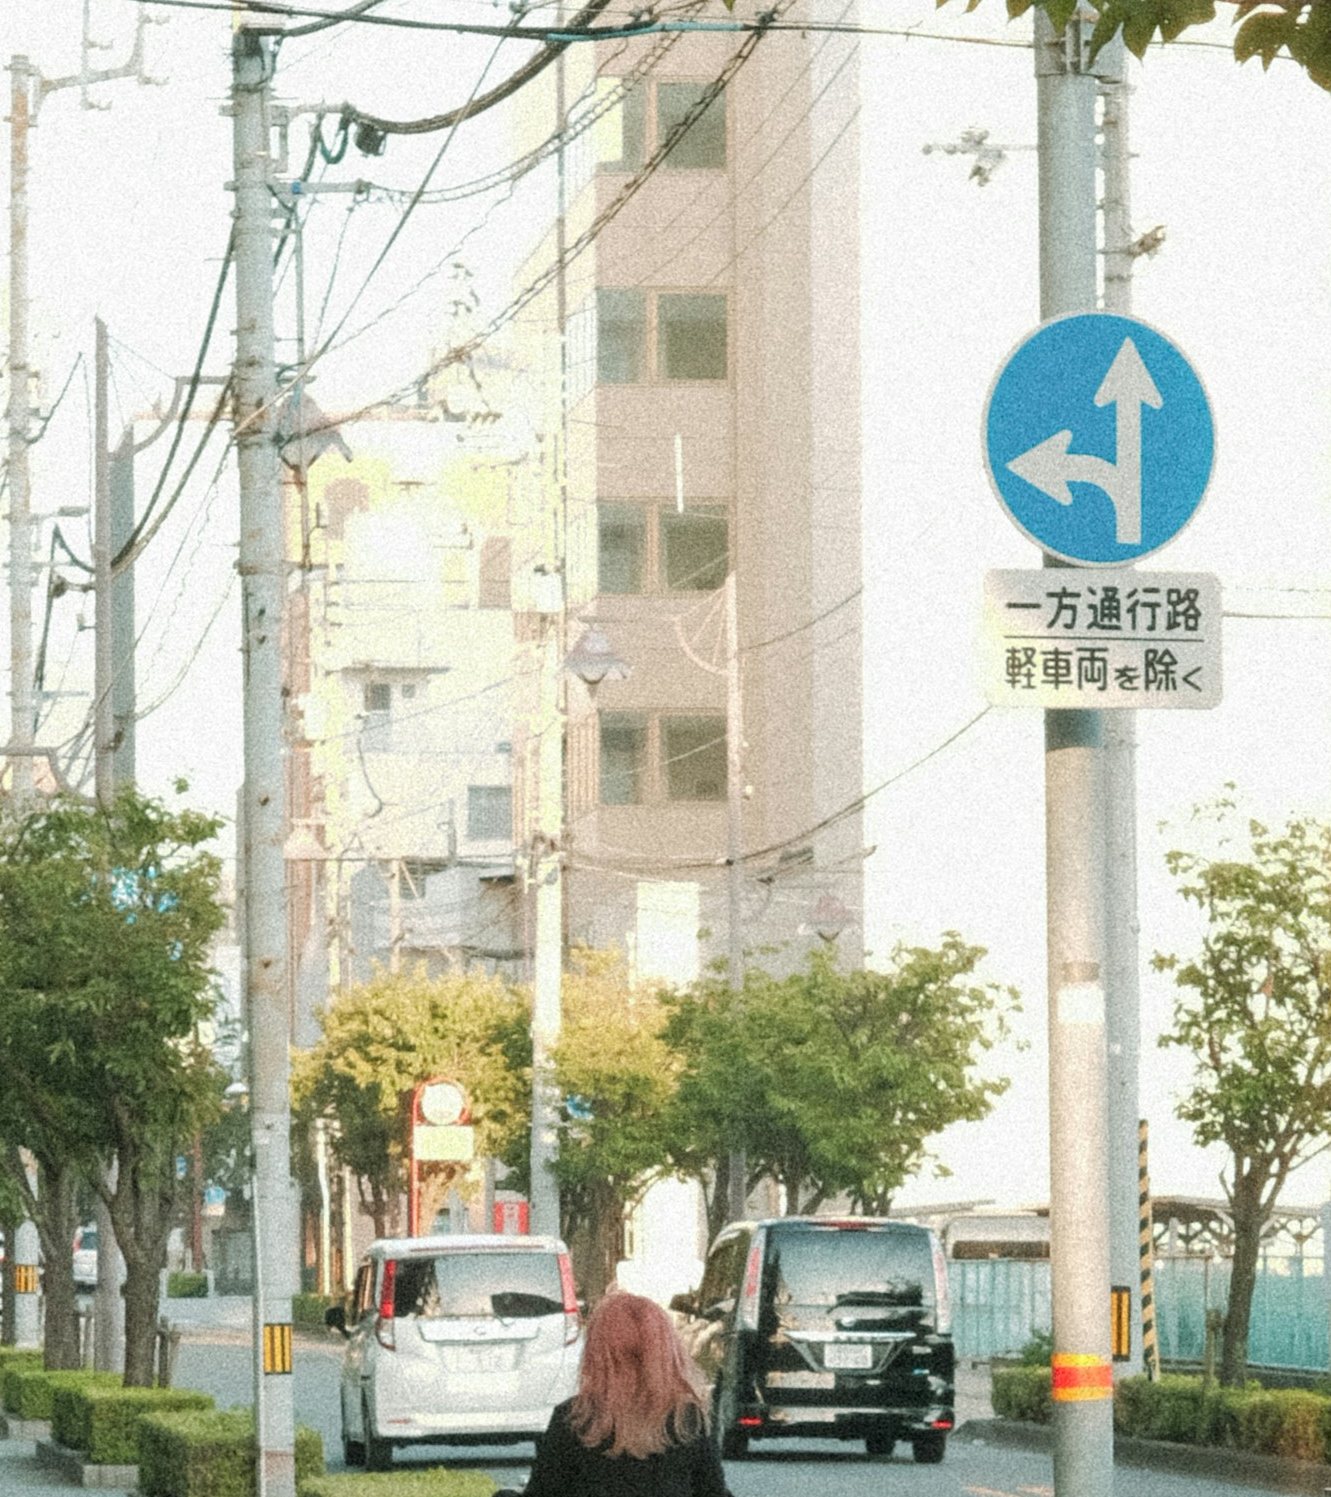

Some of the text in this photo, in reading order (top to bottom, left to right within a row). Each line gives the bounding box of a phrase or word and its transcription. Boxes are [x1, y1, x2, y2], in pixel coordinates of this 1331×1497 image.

[1006, 587, 1203, 632] 一方通行路
[1005, 647, 1203, 692] 軽車両を除く
